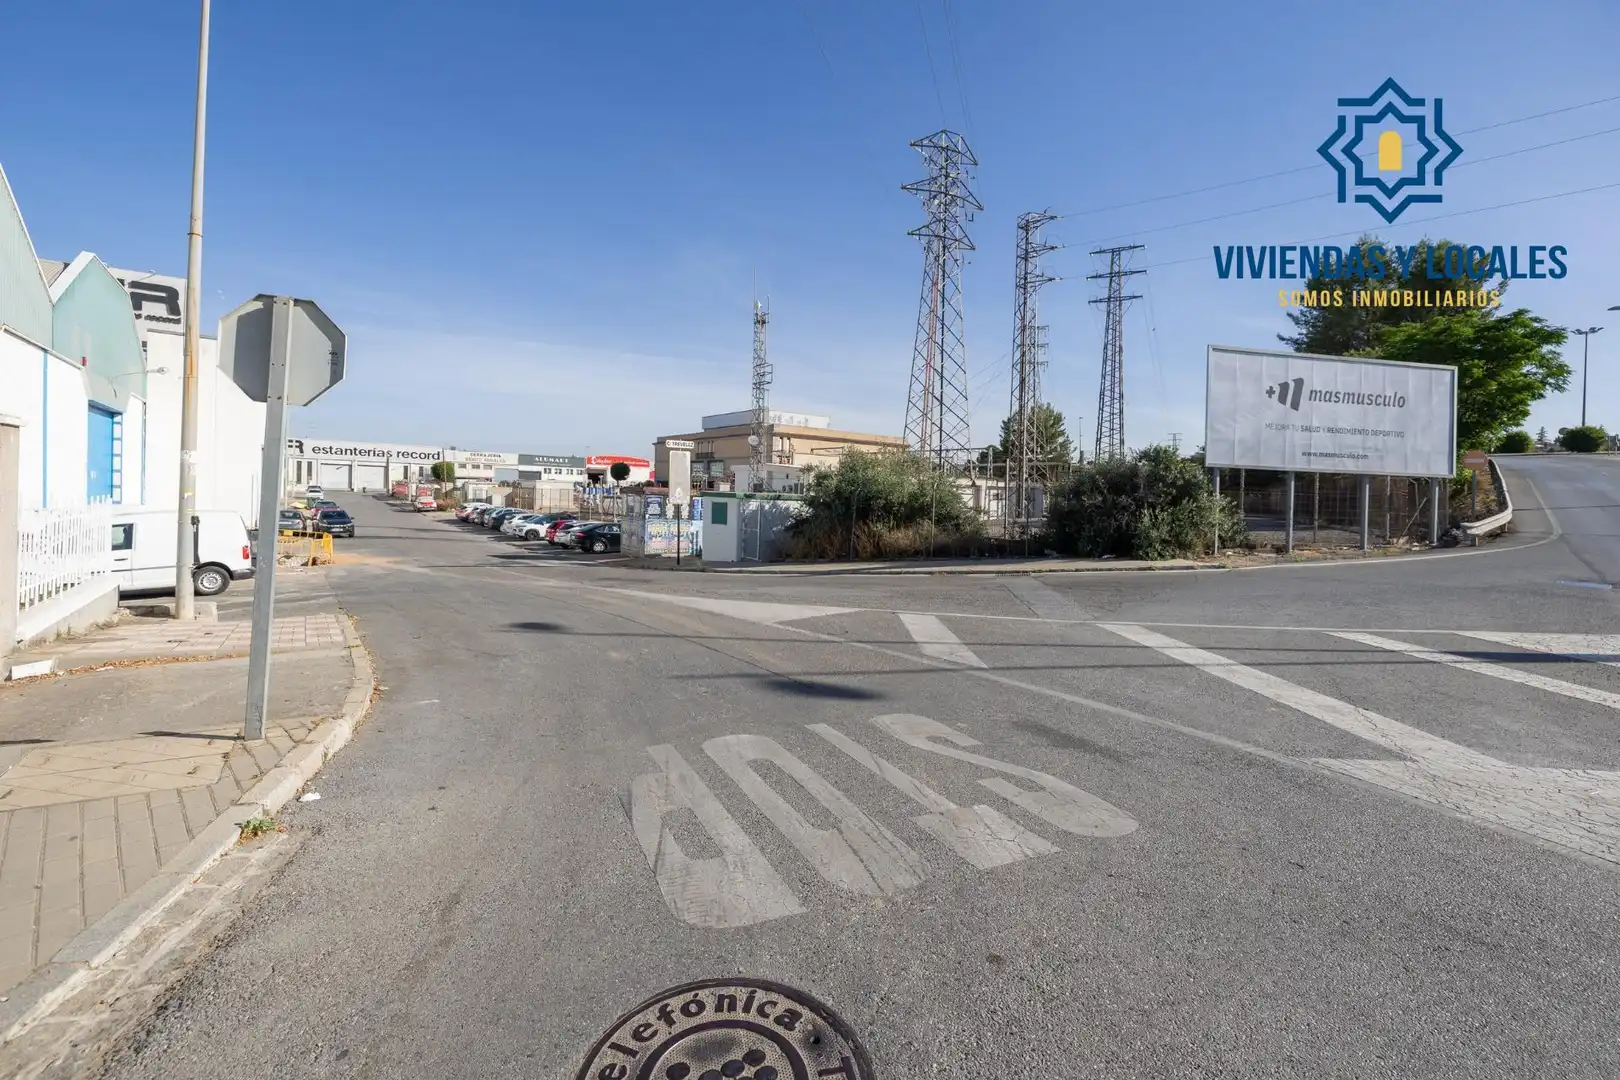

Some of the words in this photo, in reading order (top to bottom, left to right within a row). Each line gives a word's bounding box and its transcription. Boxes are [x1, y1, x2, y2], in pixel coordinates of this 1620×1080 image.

[1308, 388, 1406, 408] masmusculo
[1300, 424, 1321, 434] SALUD
[1327, 427, 1370, 437] RENDIMIENTO
[1370, 429, 1405, 438] DEPORTIVO
[396, 450, 441, 460] record
[1301, 451, 1369, 460] www.masmusculo.com
